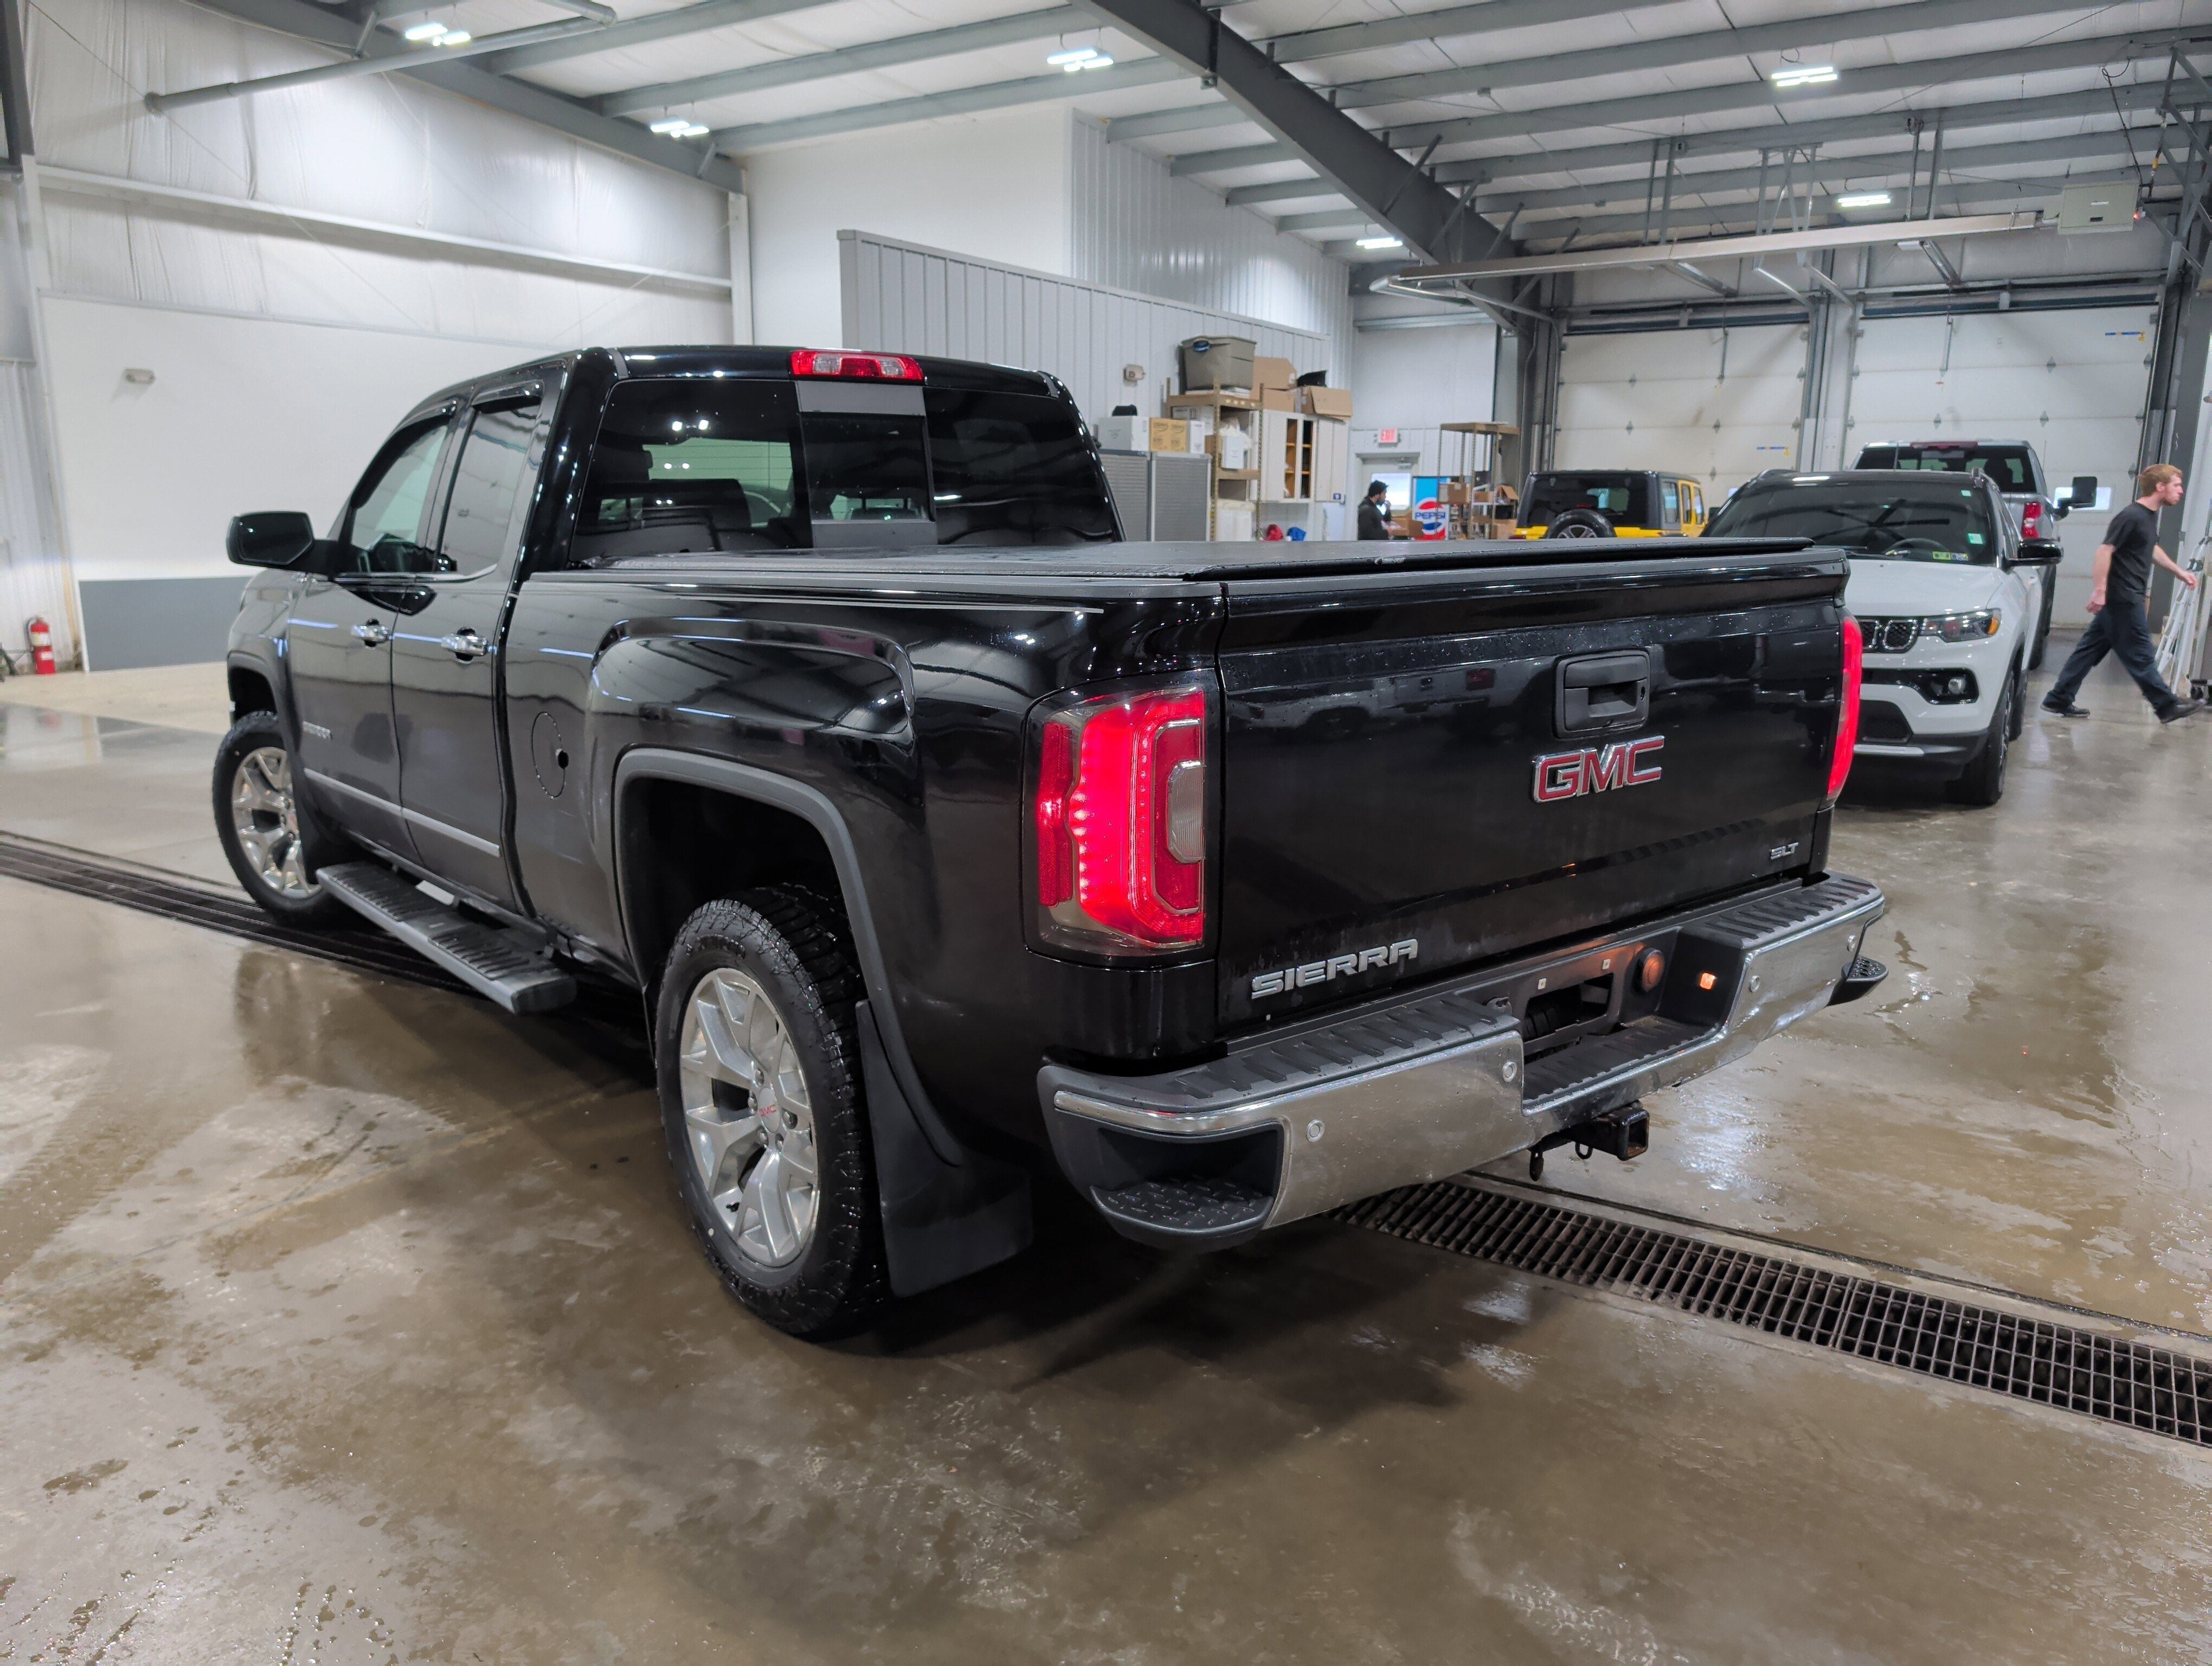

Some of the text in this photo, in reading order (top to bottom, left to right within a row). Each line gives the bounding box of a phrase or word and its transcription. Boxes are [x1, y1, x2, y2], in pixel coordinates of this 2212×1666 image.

[1533, 735, 1664, 802] GMC
[1770, 842, 1799, 860] SLT
[1251, 938, 1418, 999] SIERRA
[759, 1104, 776, 1117] GMC
